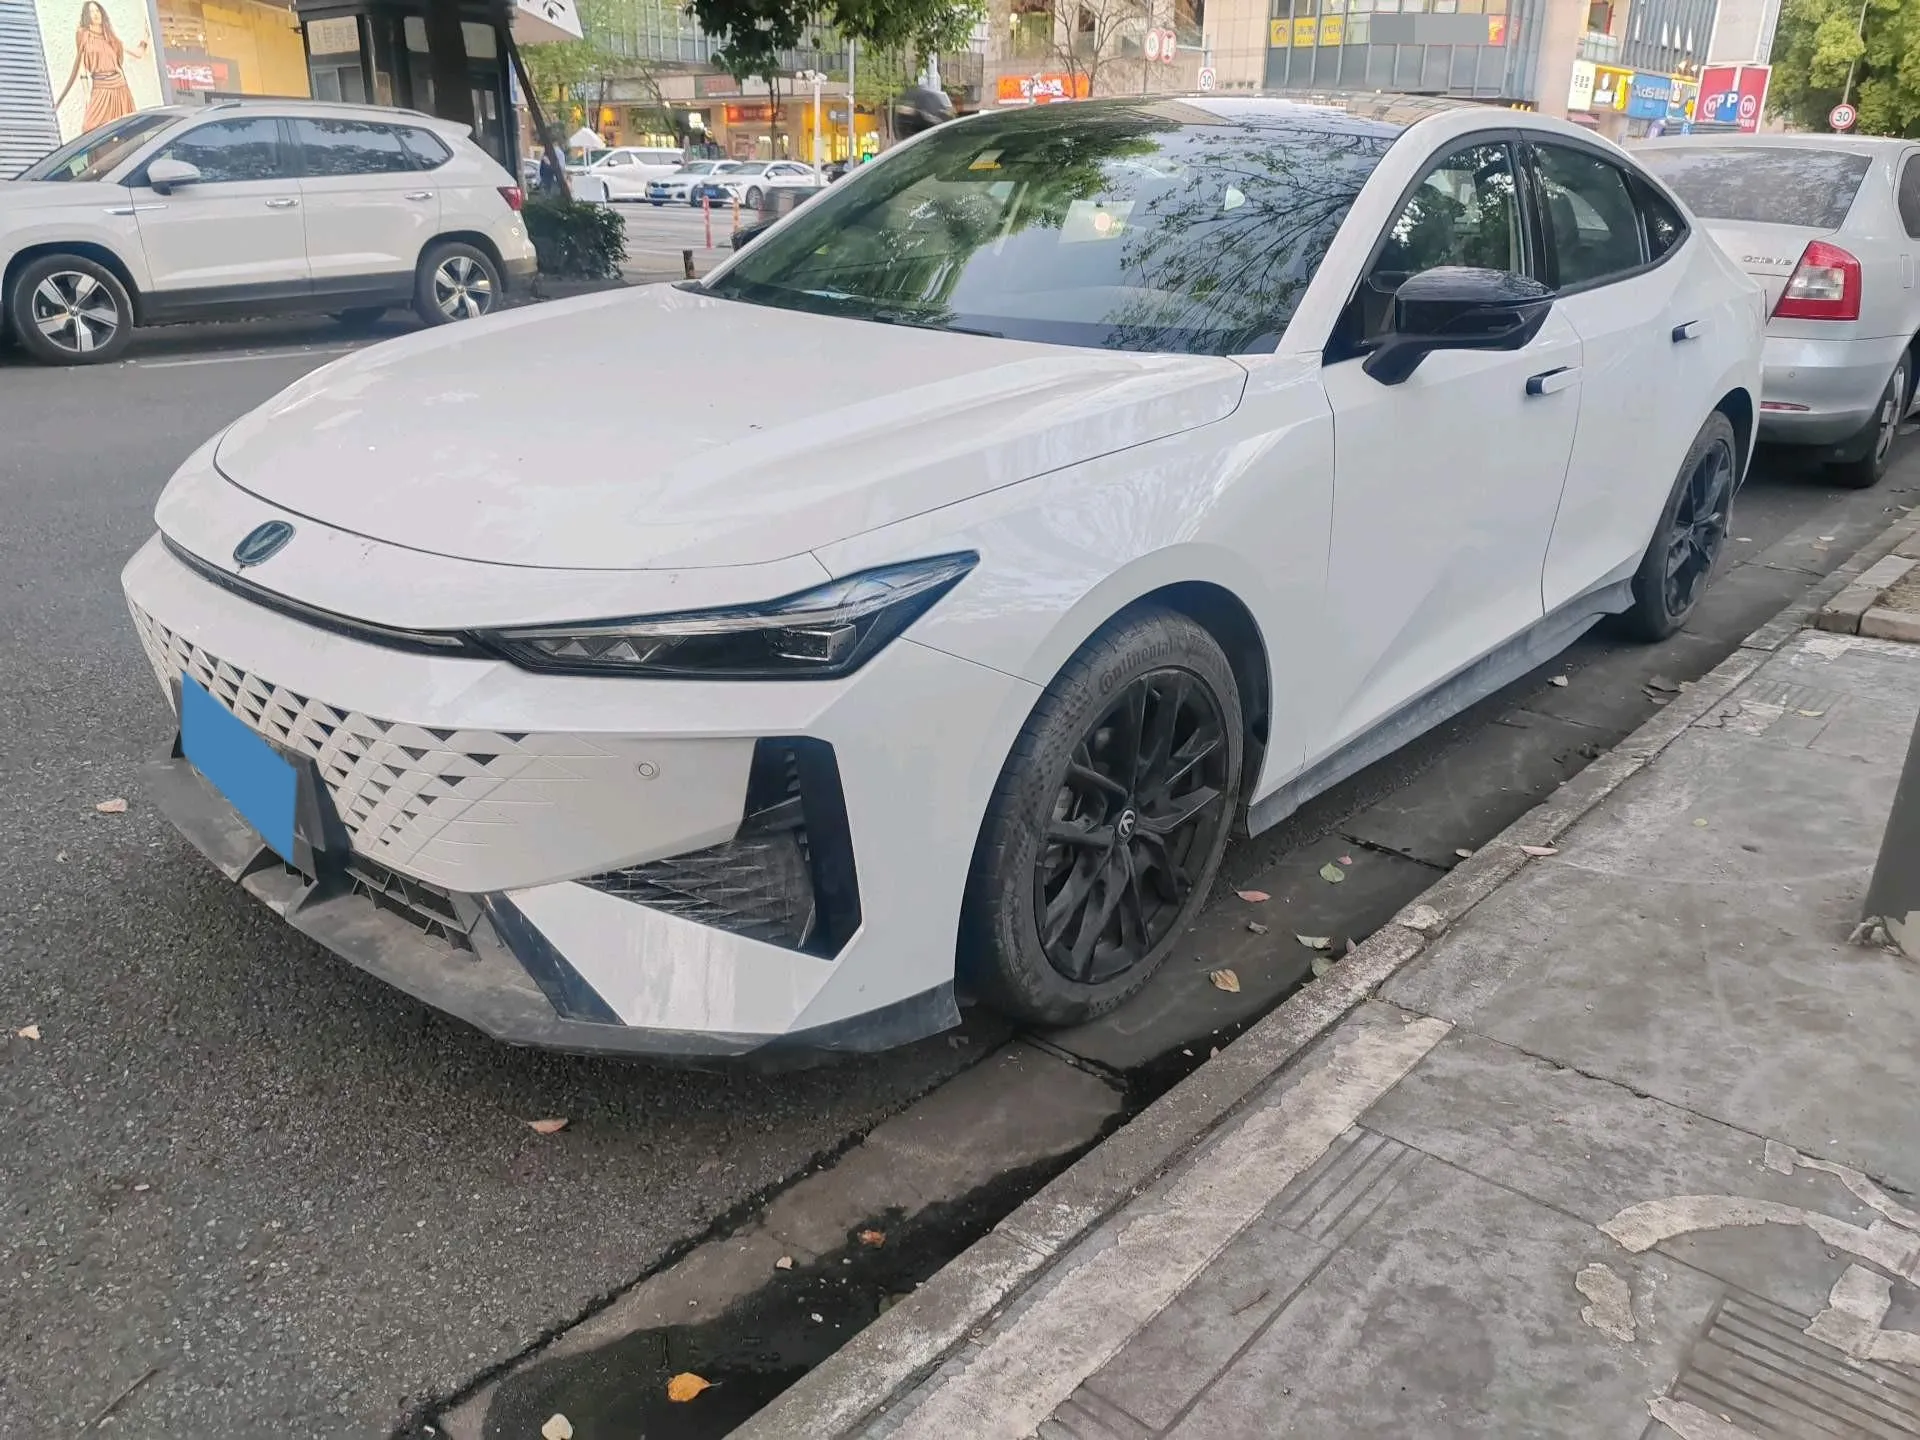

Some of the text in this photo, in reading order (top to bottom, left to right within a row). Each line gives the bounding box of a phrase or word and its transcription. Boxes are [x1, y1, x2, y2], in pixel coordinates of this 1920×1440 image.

[1202, 75, 1212, 87] 30
[1727, 93, 1738, 108] P
[1835, 111, 1850, 122] 30
[1099, 636, 1173, 695] Continental
